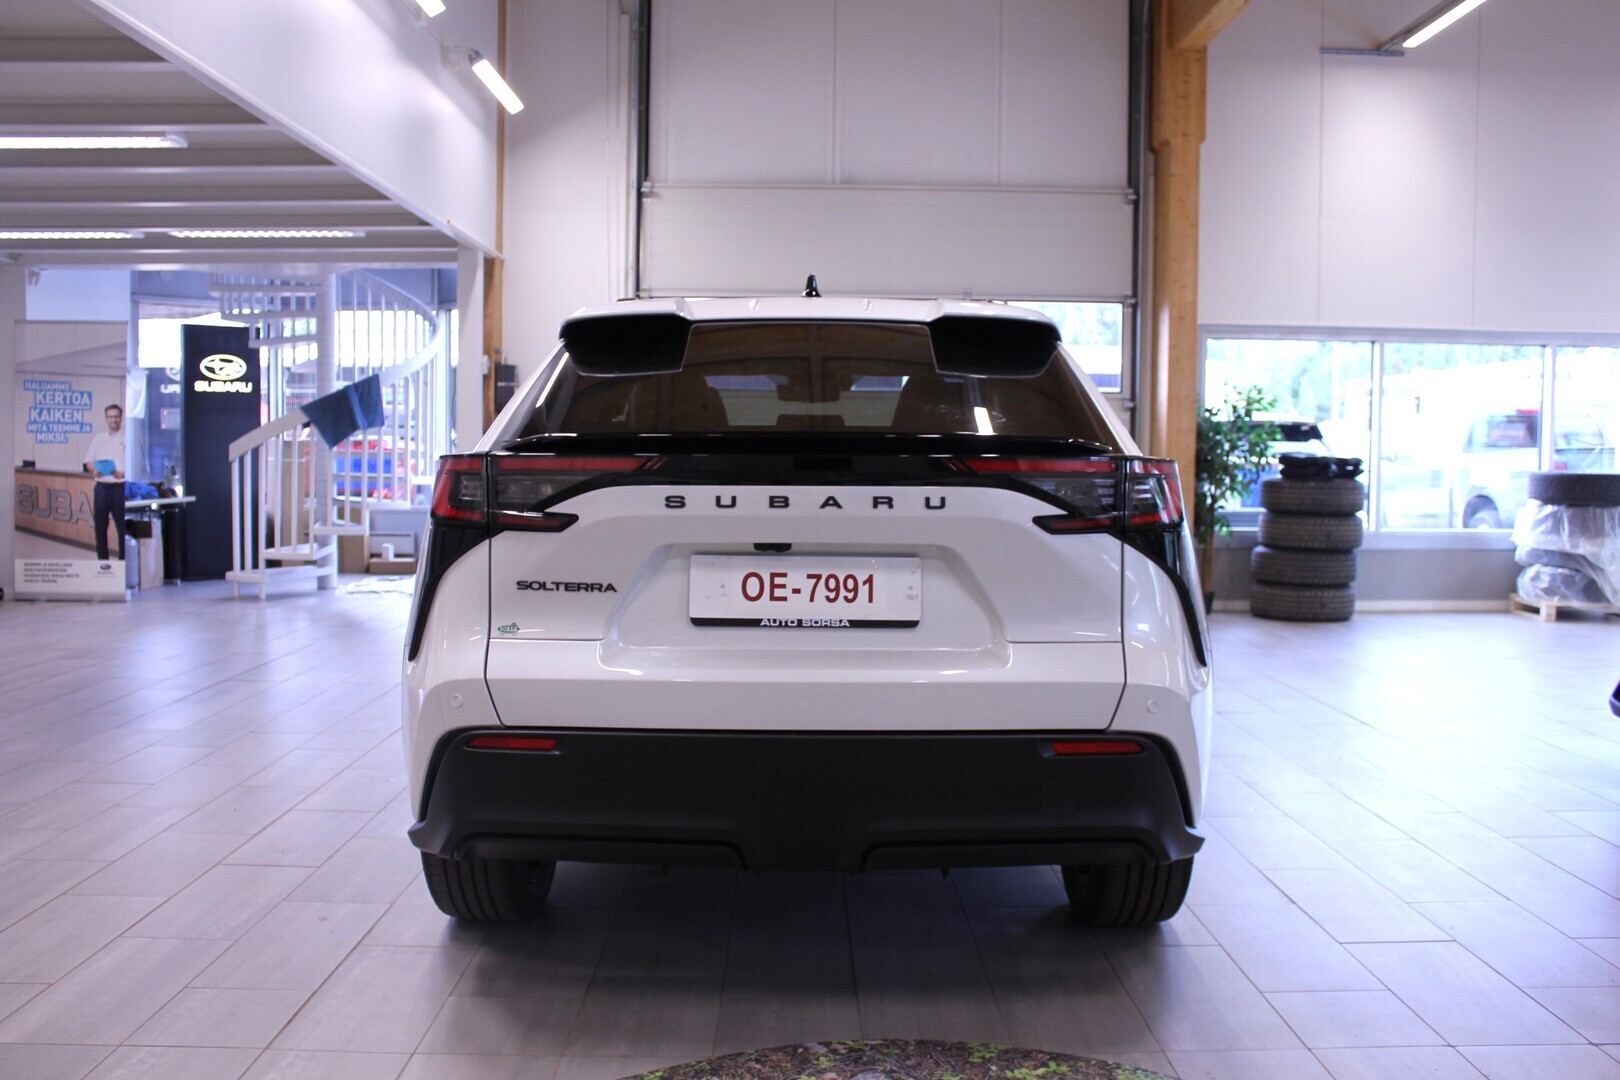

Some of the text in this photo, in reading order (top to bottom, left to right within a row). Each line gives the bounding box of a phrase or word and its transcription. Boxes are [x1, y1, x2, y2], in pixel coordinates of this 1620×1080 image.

[25, 381, 70, 391] HALUAMME
[194, 380, 253, 393] SUBARU
[36, 391, 90, 405] KERTOA
[30, 408, 82, 422] KAIKEN
[28, 422, 91, 432] MITÄ TEEMME JA
[18, 484, 95, 528] SUBA
[664, 495, 946, 509] SUBARU
[516, 580, 617, 593] SOLTERRA
[741, 571, 875, 604] OE-7991
[760, 618, 850, 628] AUTO SORSA
